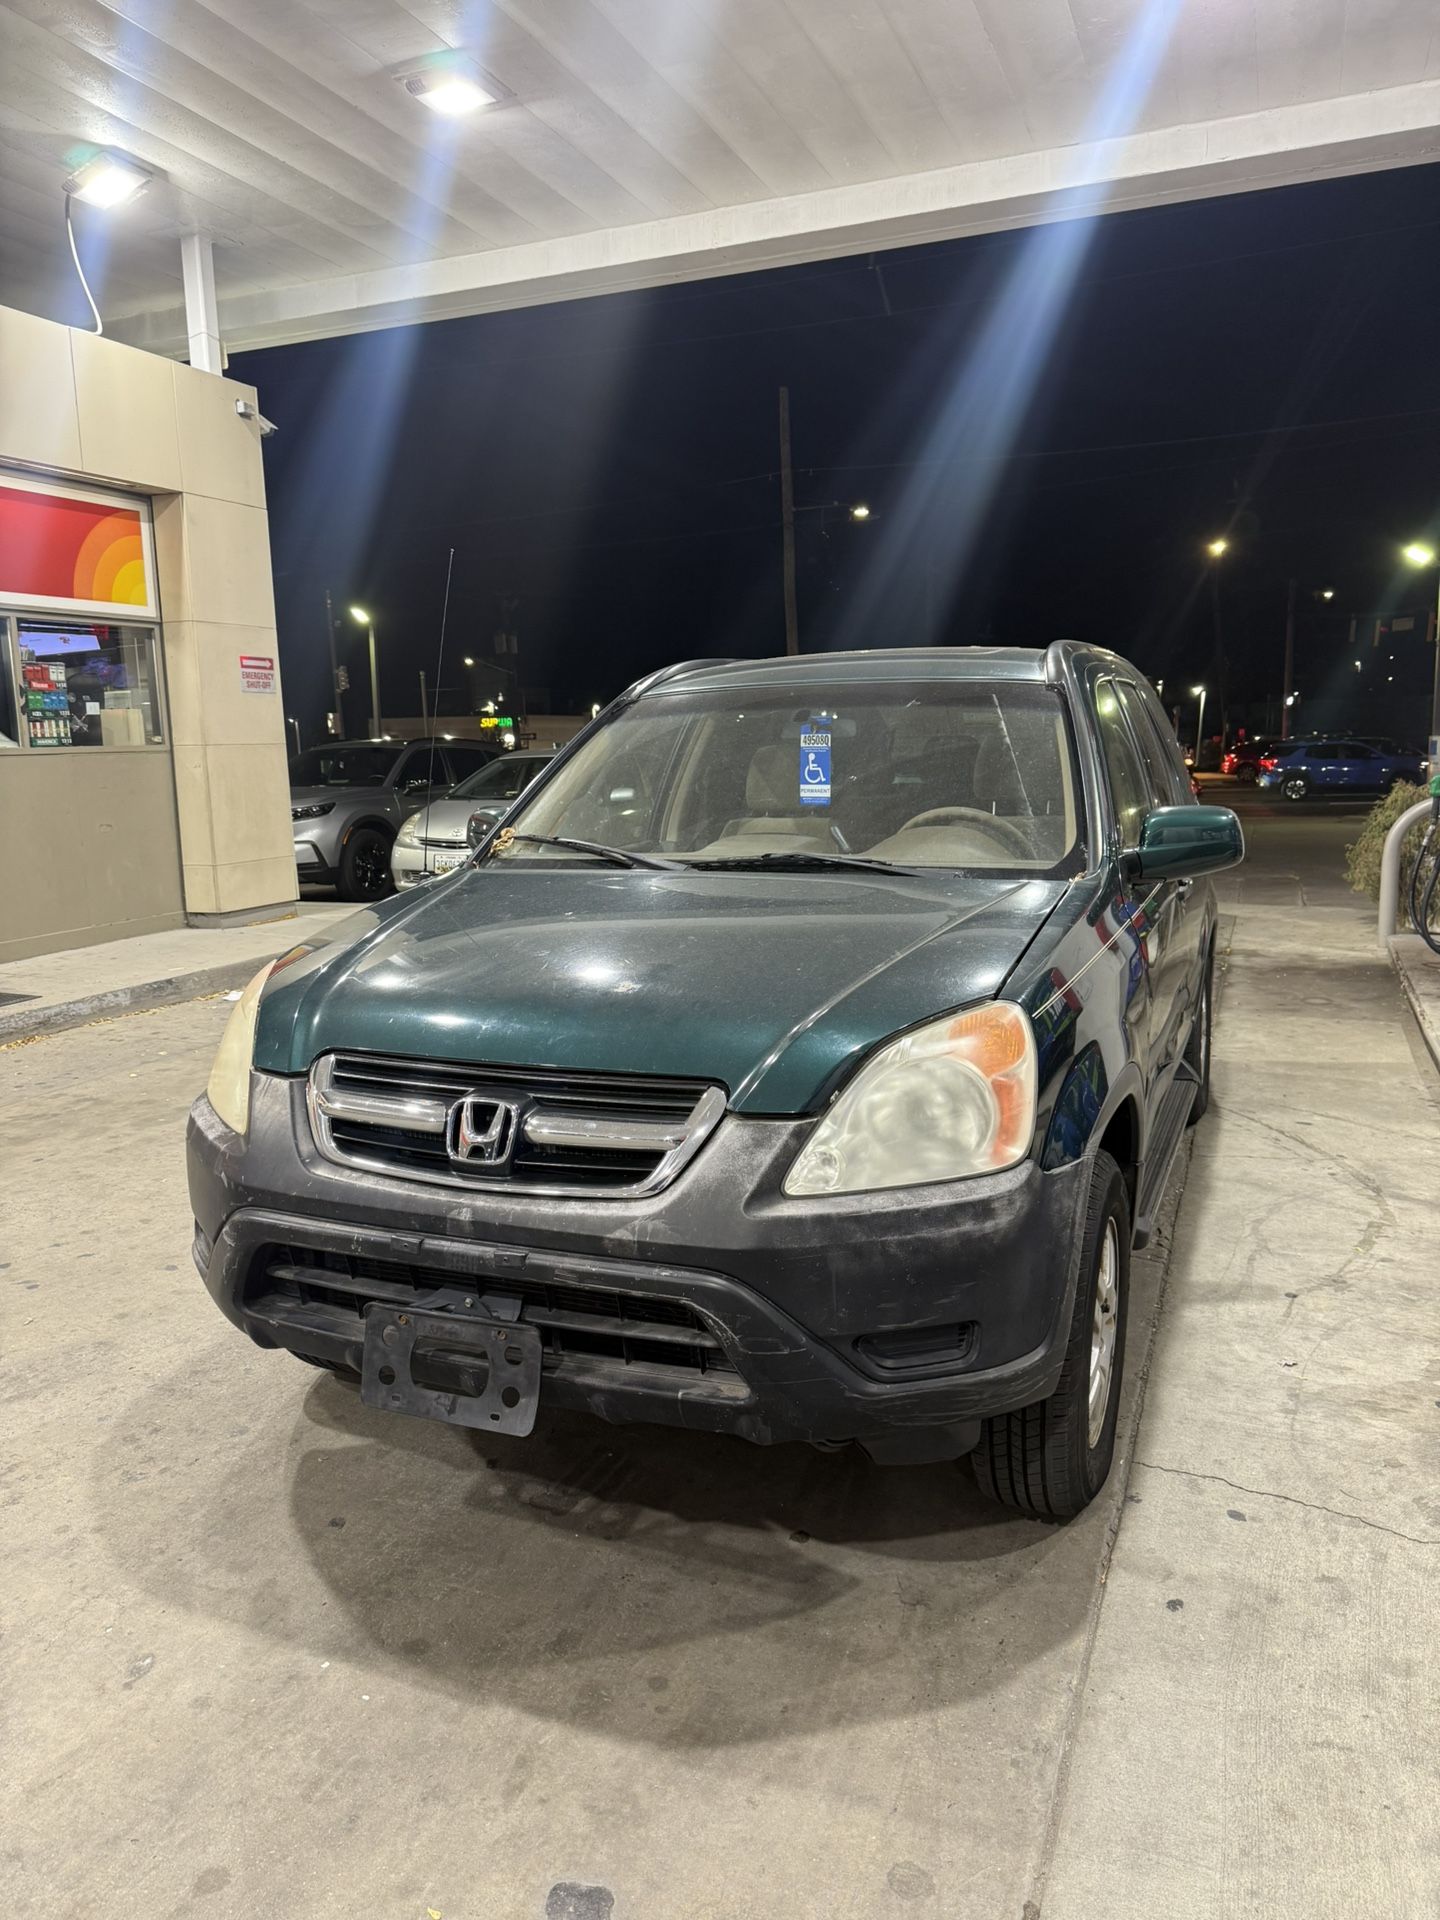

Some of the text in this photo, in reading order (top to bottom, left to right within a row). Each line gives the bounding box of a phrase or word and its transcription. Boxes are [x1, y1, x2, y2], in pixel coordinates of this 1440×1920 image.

[241, 671, 274, 680] EMERGENCY
[246, 680, 271, 688] SHUT-OFF
[480, 717, 513, 728] SUBWA
